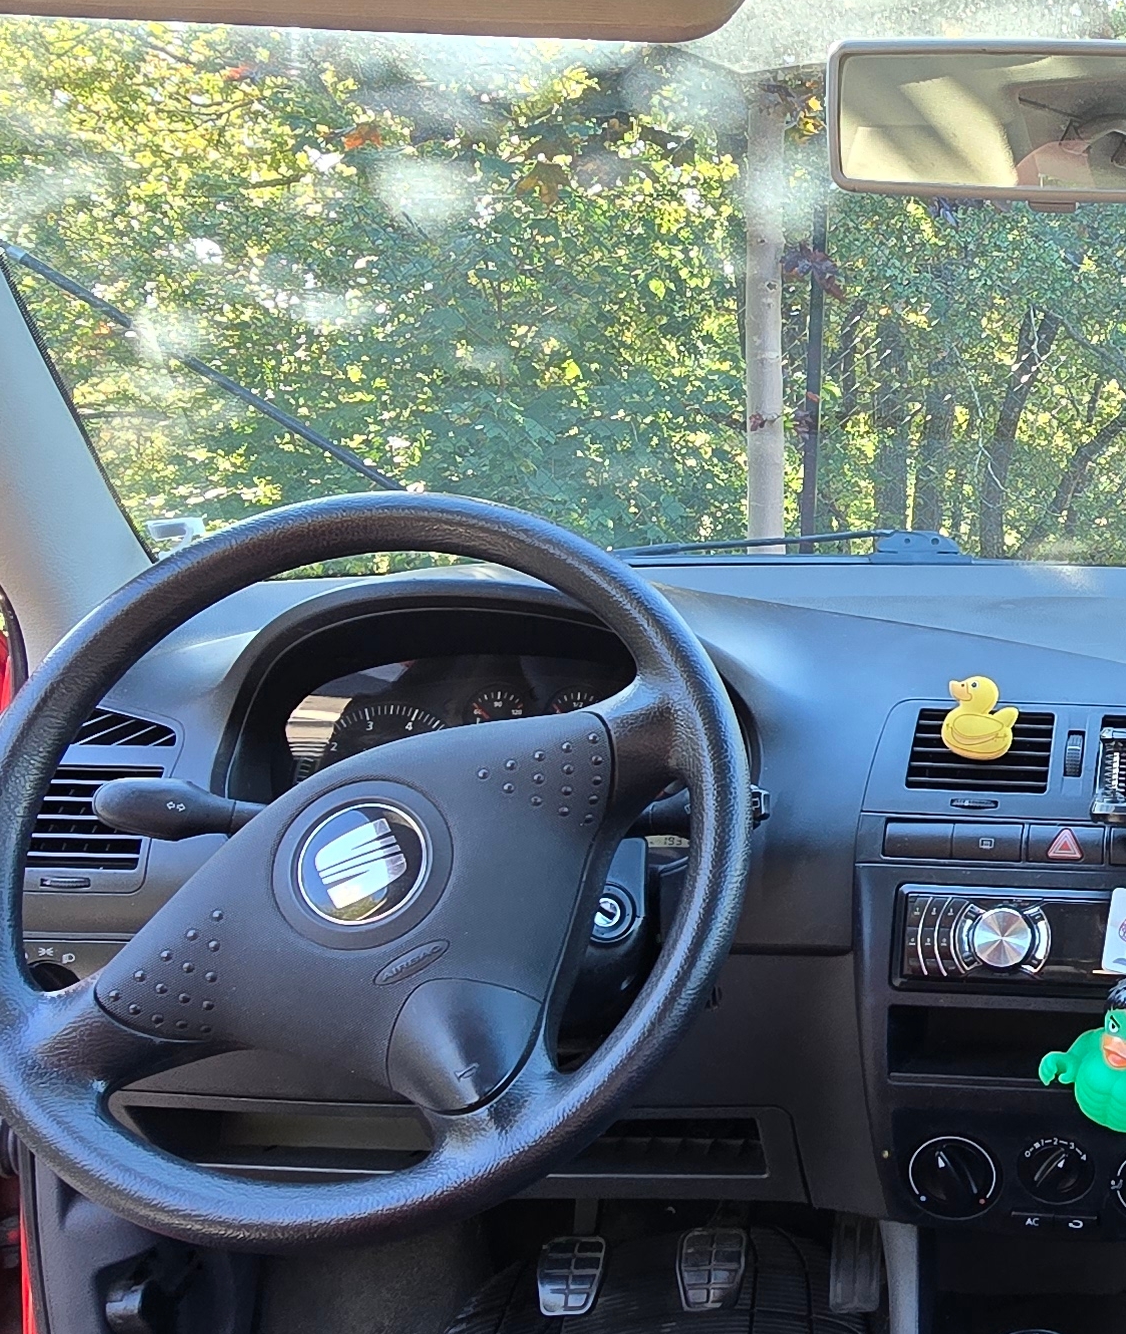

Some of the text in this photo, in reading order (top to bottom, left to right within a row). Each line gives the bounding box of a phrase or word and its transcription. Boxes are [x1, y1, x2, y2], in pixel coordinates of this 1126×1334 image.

[365, 720, 375, 731] 3
[405, 721, 414, 731] 4
[330, 741, 338, 751] 2
[1053, 1137, 1059, 1145] 2
[1069, 1141, 1075, 1150] 3
[1025, 1217, 1040, 1227] AC
